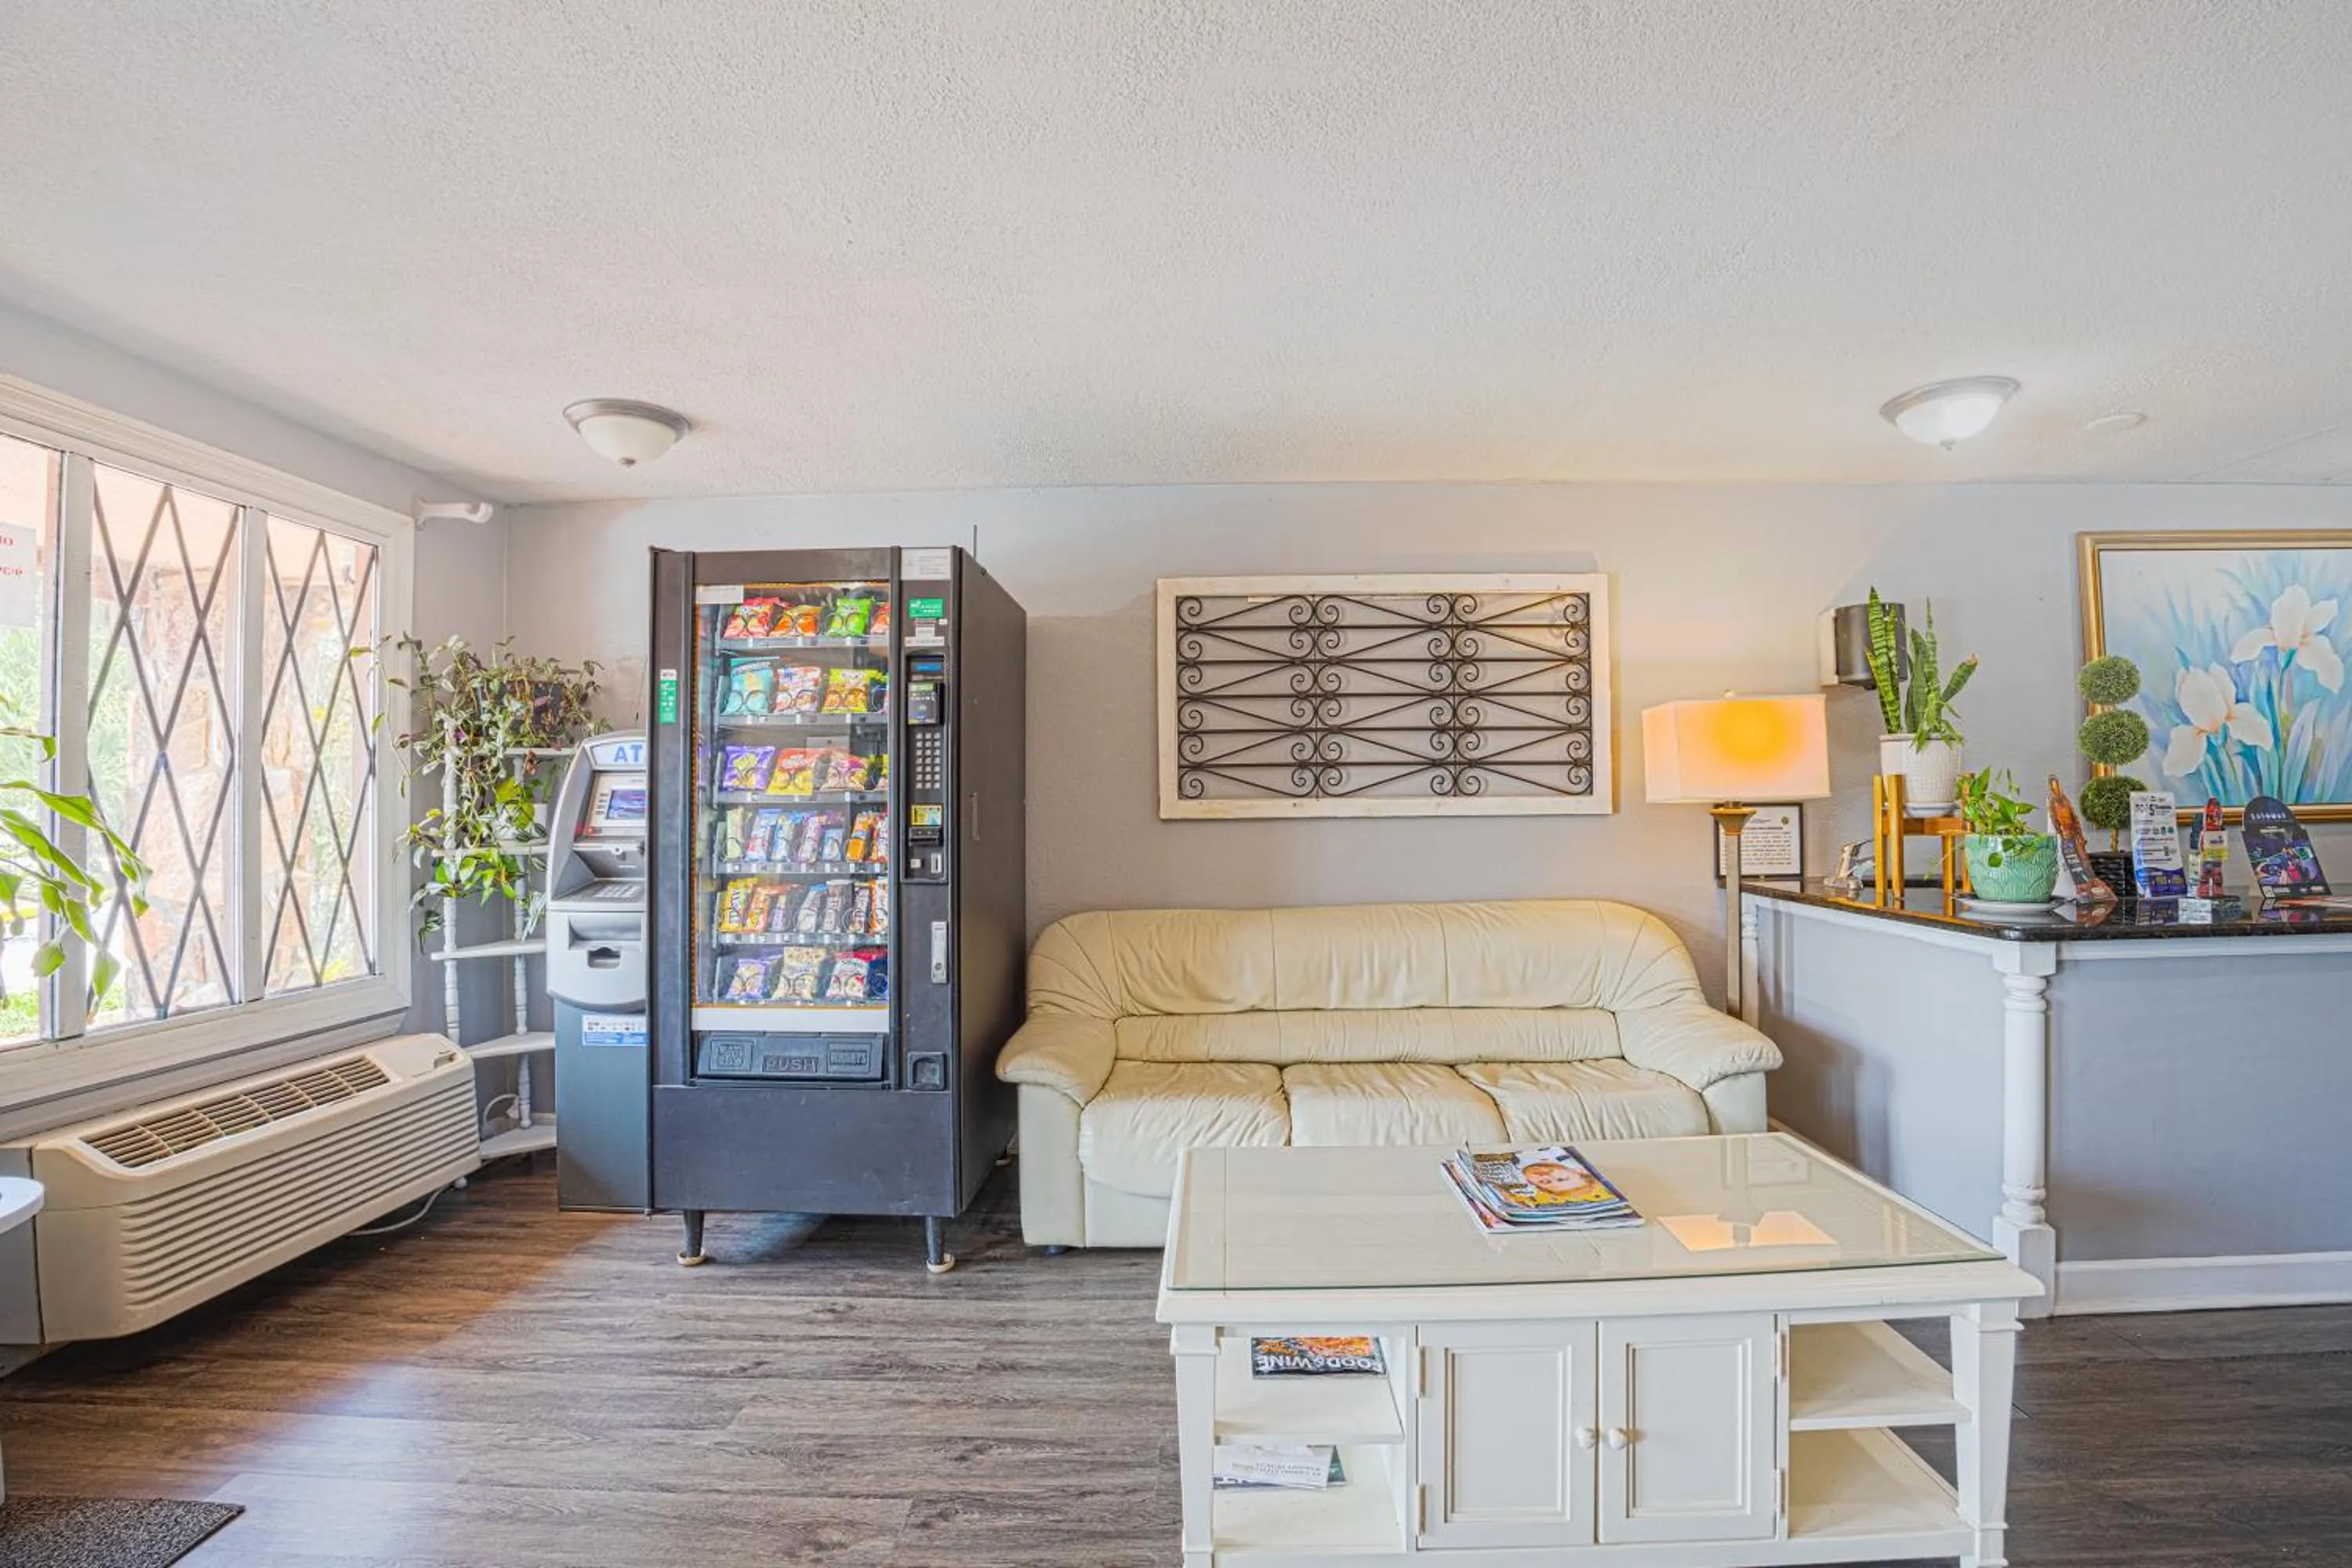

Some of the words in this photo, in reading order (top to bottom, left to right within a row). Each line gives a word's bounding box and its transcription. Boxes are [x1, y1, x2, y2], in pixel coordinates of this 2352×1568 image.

[614, 745, 644, 762] AT
[766, 1058, 816, 1072] PUSH
[1256, 1355, 1312, 1372] WINE
[1327, 1356, 1384, 1374] FOOD
